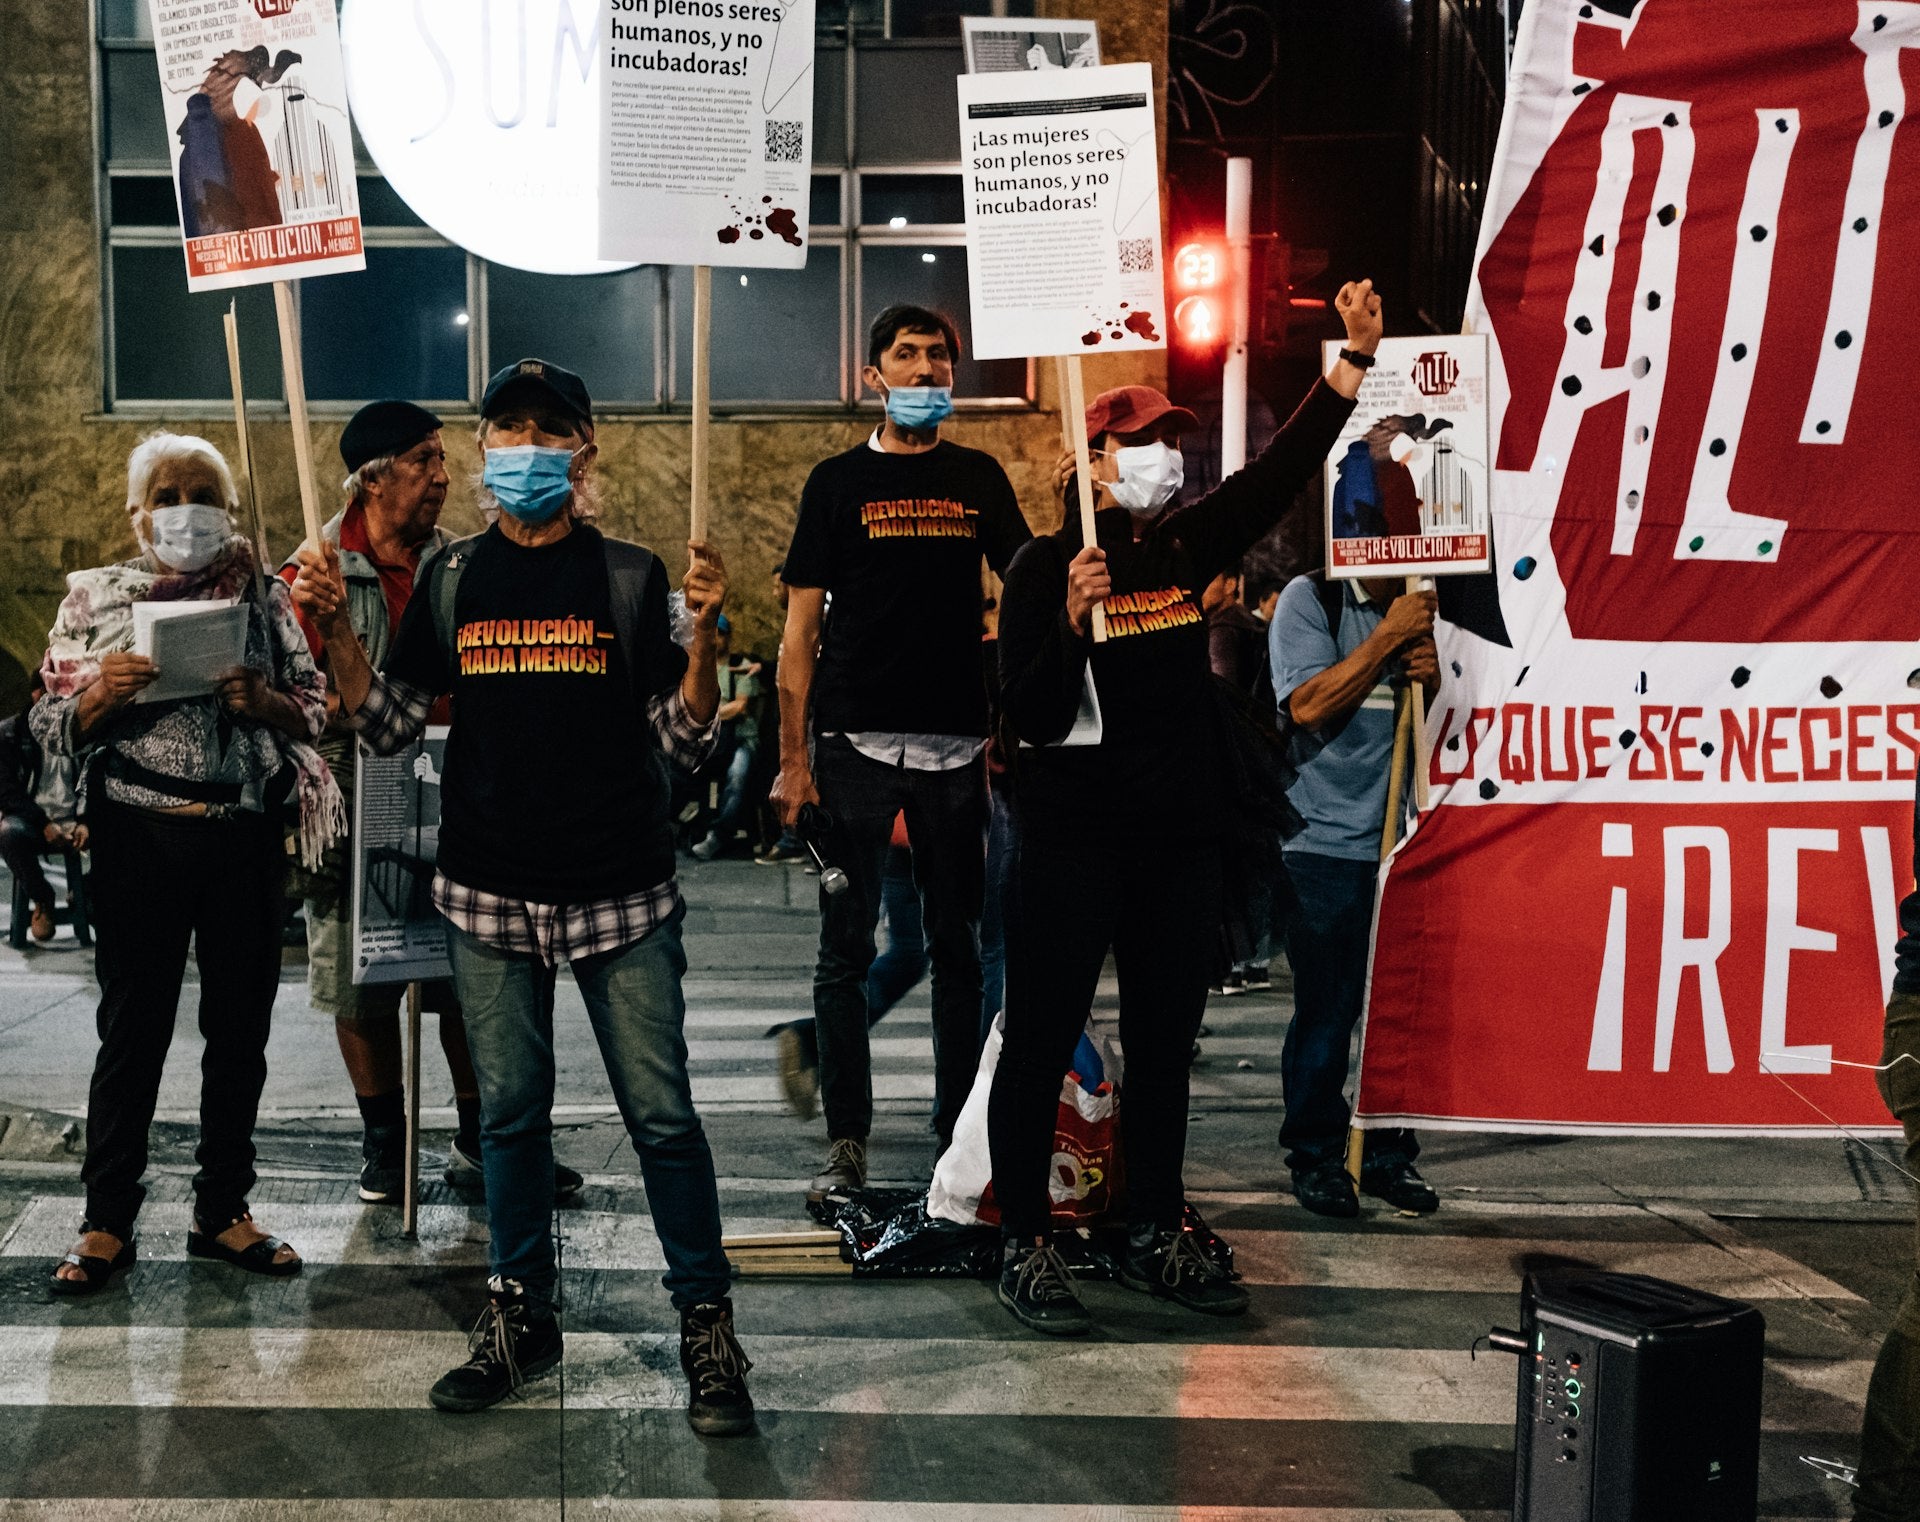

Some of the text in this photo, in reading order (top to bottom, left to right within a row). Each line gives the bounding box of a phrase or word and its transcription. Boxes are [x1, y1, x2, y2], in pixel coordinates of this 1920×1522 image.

[611, 0, 781, 22] son plenos seres
[611, 17, 763, 52] humanos, y no
[610, 46, 748, 77] incubadoras!
[973, 126, 1089, 151] ¡Las mujeres
[973, 147, 1125, 172] son plenos seres
[975, 171, 1109, 192] humanos, y no
[976, 192, 1097, 215] incubadoras!
[327, 220, 354, 237] Y NADA
[191, 238, 225, 251] LO QUE SE
[327, 237, 357, 253] MENOS!
[1183, 252, 1216, 286] 23
[868, 519, 977, 539] NADA MENOS!
[1139, 602, 1203, 633] MENOS!
[460, 646, 607, 676] NADA MENOS!
[1500, 703, 1616, 784] QUE
[1629, 704, 1705, 782] SE
